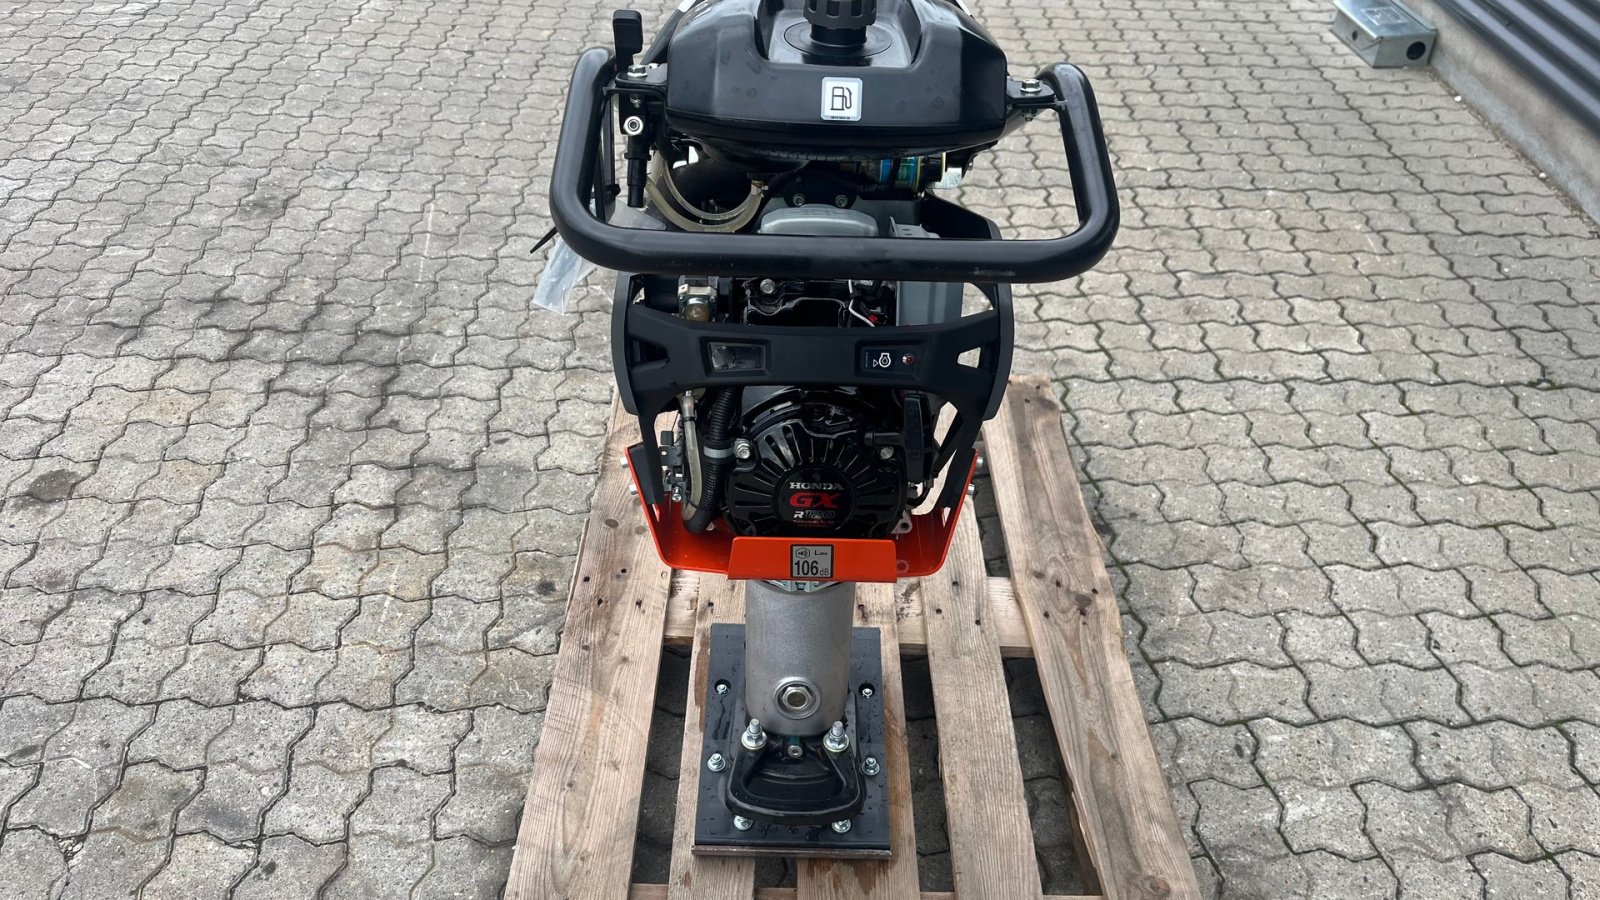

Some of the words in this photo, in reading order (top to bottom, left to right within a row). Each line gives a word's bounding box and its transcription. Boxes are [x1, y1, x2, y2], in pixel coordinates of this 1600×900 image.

[789, 482, 844, 490] HONDA
[789, 491, 845, 509] GX
[794, 560, 819, 576] 106
